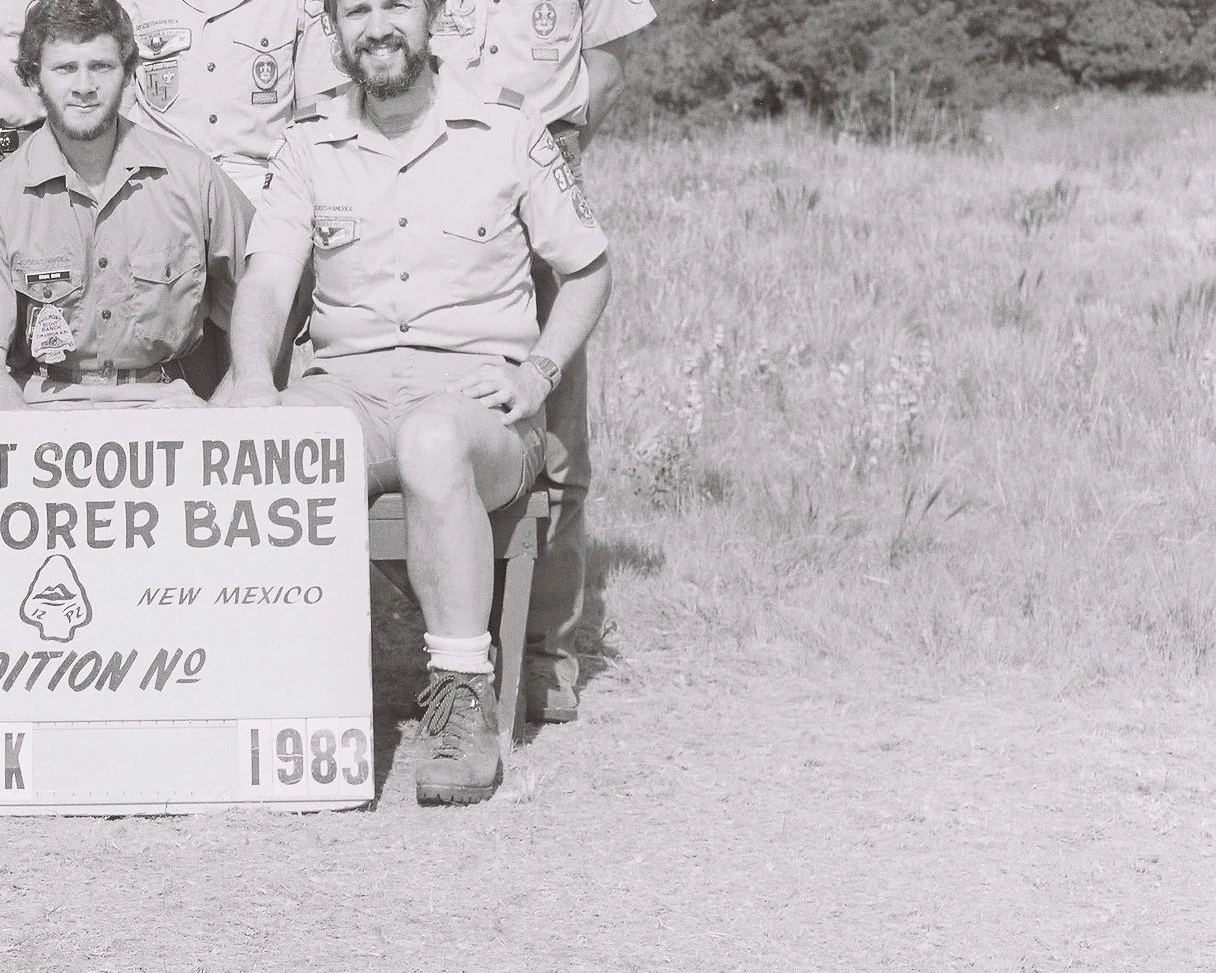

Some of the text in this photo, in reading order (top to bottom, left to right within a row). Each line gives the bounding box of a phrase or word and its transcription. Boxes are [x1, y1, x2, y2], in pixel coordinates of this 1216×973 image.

[33, 441, 184, 489] SCOUT
[202, 438, 344, 486] RANCH
[184, 498, 336, 548] BASE
[137, 586, 323, 606] NEW MEXICO
[5, 733, 25, 789] K
[251, 729, 370, 786] 1983
